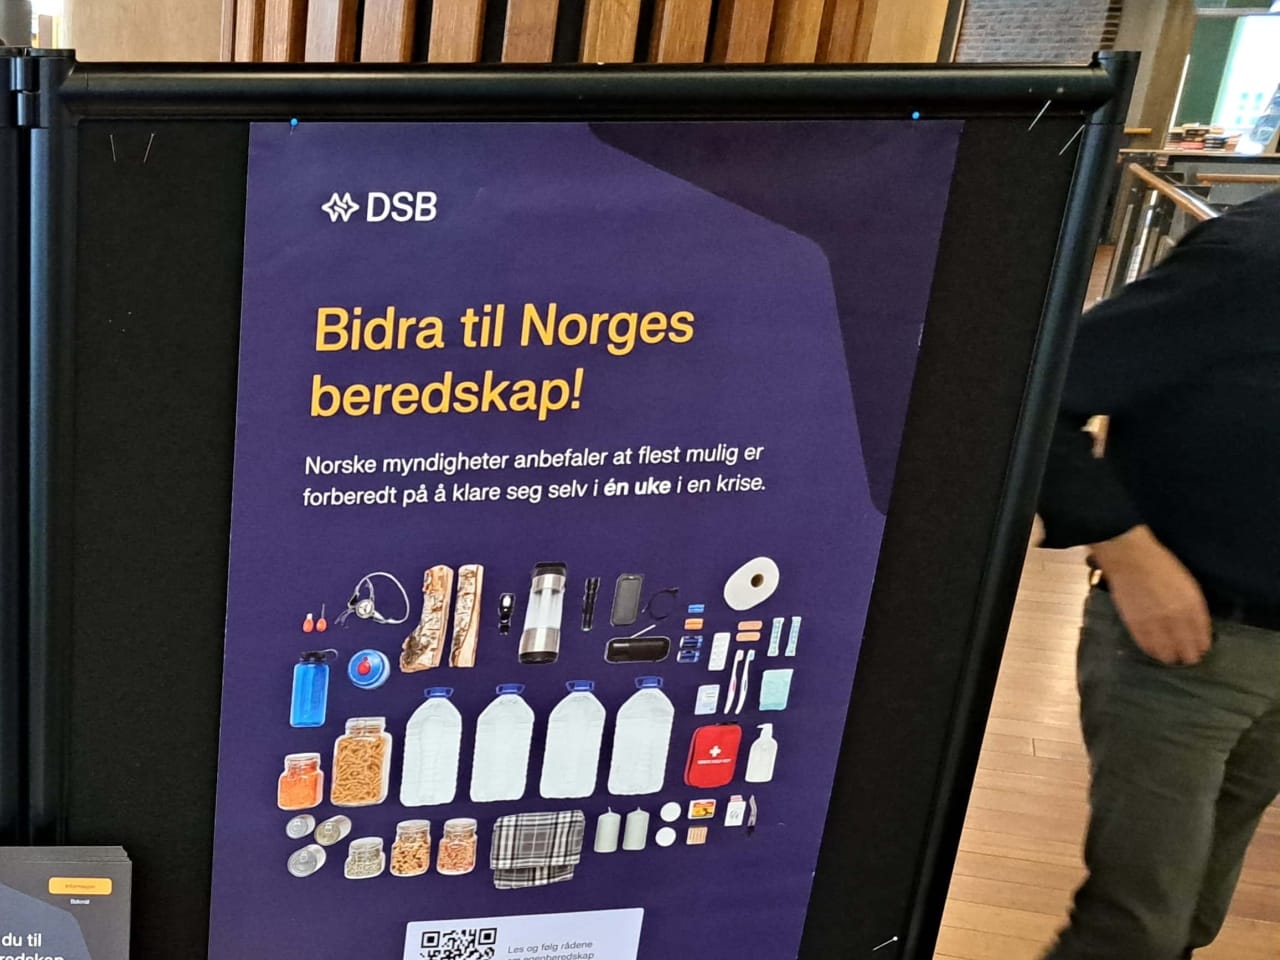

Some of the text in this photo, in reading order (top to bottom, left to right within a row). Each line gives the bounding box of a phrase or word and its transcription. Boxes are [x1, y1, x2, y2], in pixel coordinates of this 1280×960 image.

[367, 192, 437, 222] DSB
[315, 303, 694, 356] Bidra til Norges
[310, 368, 584, 421] beredskap!
[305, 444, 763, 475] Norske myndigheter anbefaler at flest mulig er
[303, 474, 766, 506] forberedt på å klare seg selv i én uke i en krise.
[2, 933, 23, 947] du
[27, 933, 42, 947] til
[508, 941, 593, 954] Les og følg rådene
